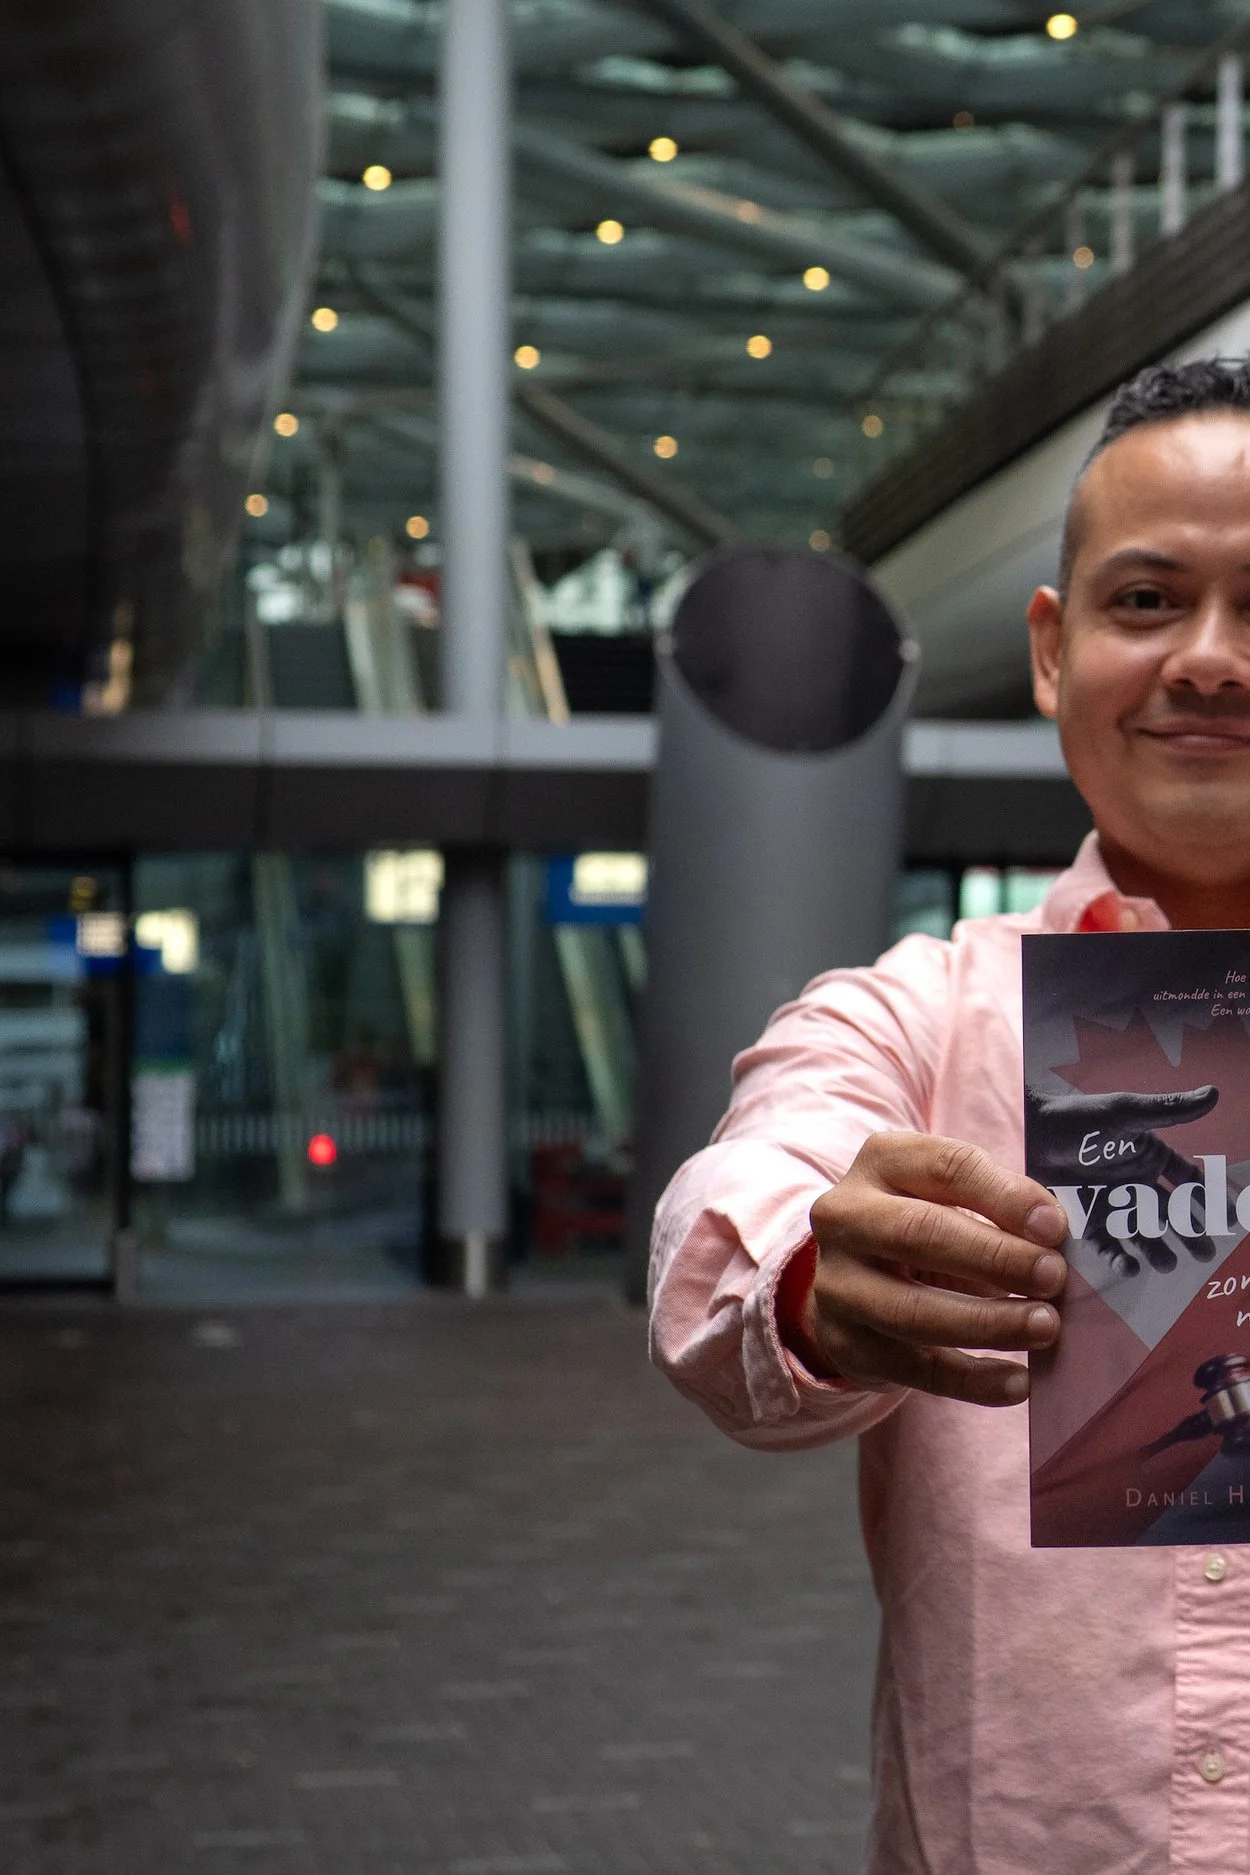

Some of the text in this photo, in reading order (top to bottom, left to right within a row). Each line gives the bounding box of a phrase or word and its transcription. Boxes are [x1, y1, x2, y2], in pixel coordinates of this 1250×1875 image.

[1225, 970, 1246, 984] Hoe
[1153, 989, 1209, 1000] uitmondde
[1213, 989, 1223, 999] in
[1227, 991, 1246, 999] een
[1210, 1004, 1233, 1016] Een
[1078, 1131, 1136, 1166] Een
